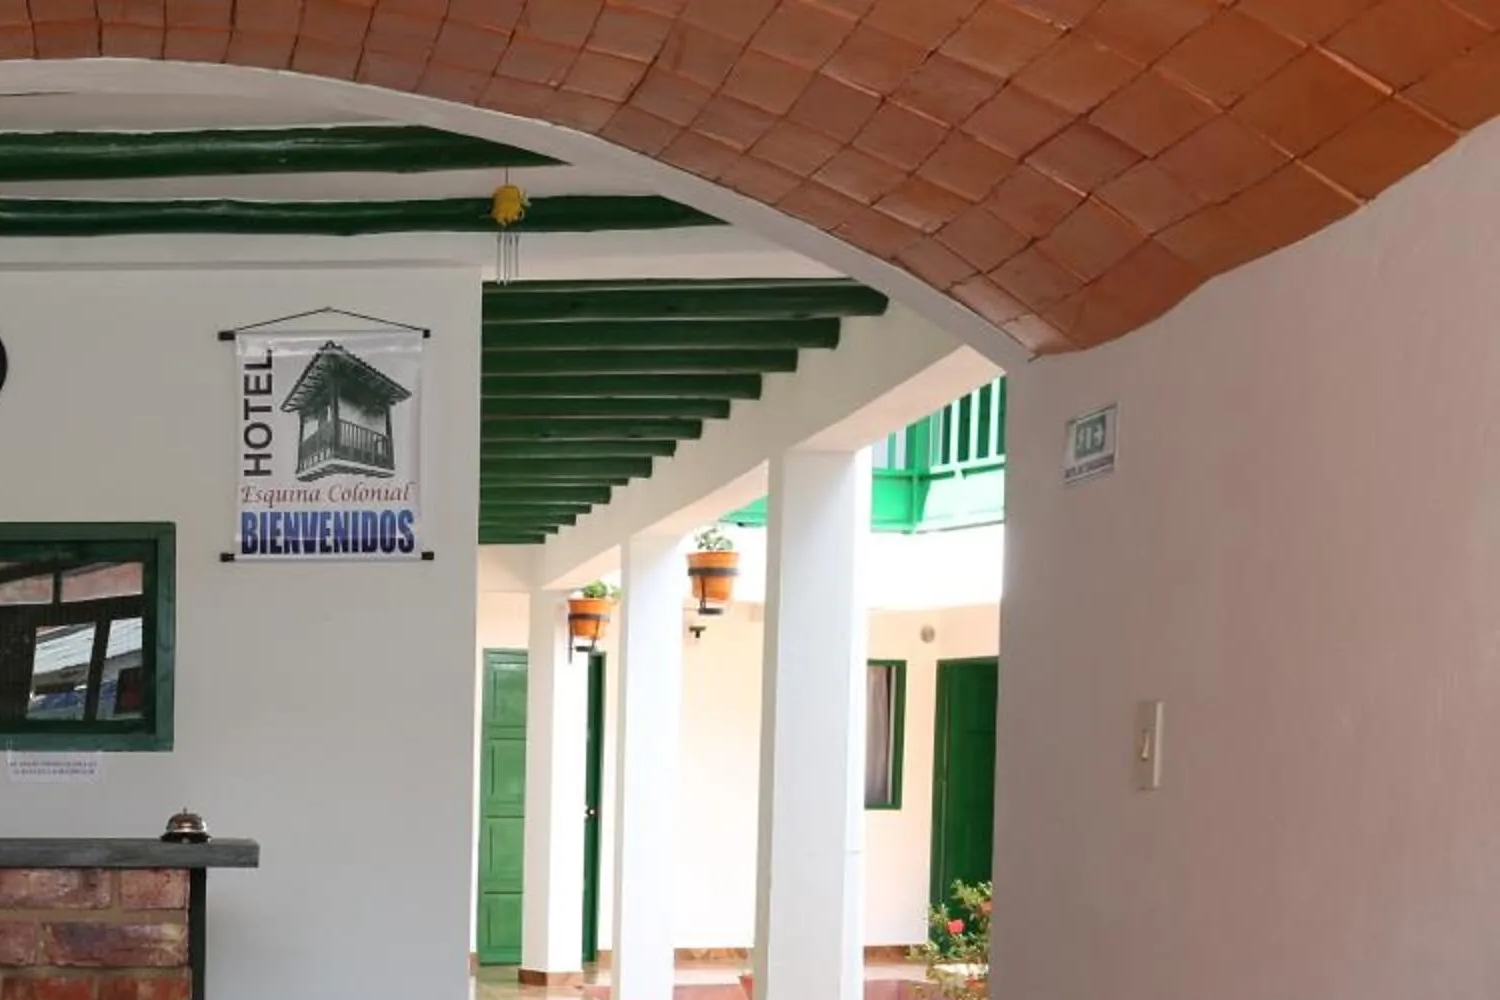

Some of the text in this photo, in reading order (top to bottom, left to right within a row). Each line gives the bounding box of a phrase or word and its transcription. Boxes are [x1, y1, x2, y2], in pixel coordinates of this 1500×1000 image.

[243, 349, 273, 477] HOTEL
[241, 482, 414, 508] Esquina Colonial
[241, 509, 416, 554] BIENVENIDOS
